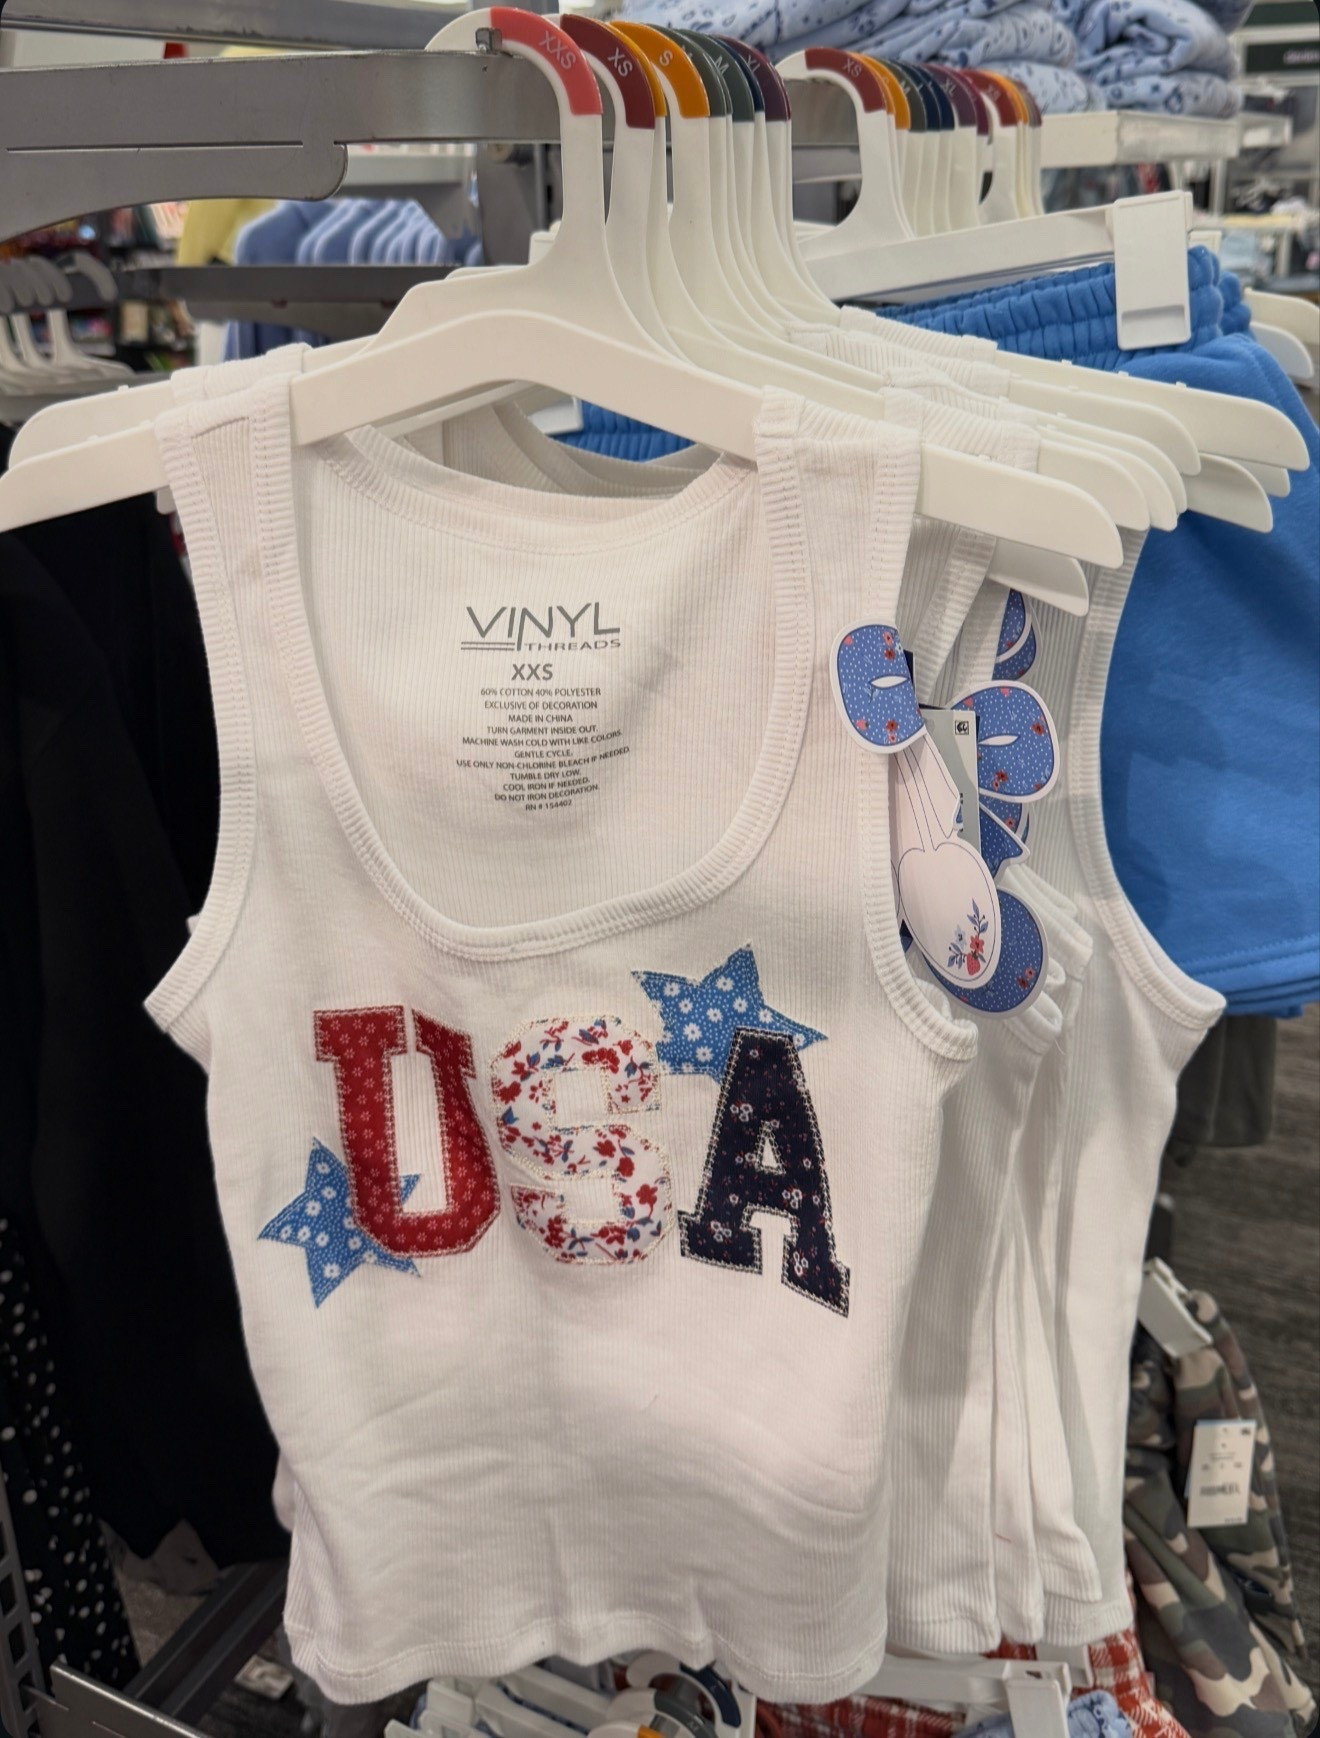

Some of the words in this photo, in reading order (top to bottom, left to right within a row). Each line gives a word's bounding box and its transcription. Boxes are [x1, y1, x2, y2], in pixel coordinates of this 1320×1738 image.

[539, 30, 577, 70] XXS
[607, 47, 634, 77] XS
[658, 50, 674, 67] S
[842, 57, 863, 78] XS
[465, 601, 621, 651] VINYL
[525, 639, 621, 651] THREADS
[511, 663, 554, 681] XXS
[480, 688, 498, 696] 60%
[499, 688, 533, 697] COTTON
[535, 688, 553, 697] 40%
[554, 687, 601, 697] POLYESTER
[484, 700, 527, 710] EXCLUSIVE
[528, 701, 539, 710] OF
[542, 701, 598, 710] DECORATION
[508, 714, 533, 723] MADE
[535, 714, 544, 723] IN
[545, 714, 573, 723] CHINA
[487, 726, 508, 735] TURN
[510, 726, 548, 735] GARMENT
[550, 726, 577, 735] INSIDE
[462, 736, 498, 746] MACHINE
[500, 738, 524, 747] WASH
[525, 738, 548, 747] COLD
[549, 738, 571, 746] WITH
[572, 736, 589, 745] LIKE
[514, 750, 544, 759] GENTLE
[456, 759, 471, 768] USE
[472, 760, 494, 769] ONLY
[496, 761, 556, 770] NON-CHLORINE
[558, 757, 590, 768] BLEACH
[591, 755, 598, 763] IF
[510, 772, 542, 781] TUMBLE
[543, 771, 560, 780] DRY
[503, 783, 526, 792] COOL
[527, 782, 547, 791] IRON
[494, 793, 507, 801] DO
[508, 793, 525, 802] NOT
[527, 793, 547, 801] IRON
[525, 803, 537, 812] RN
[313, 1004, 850, 1319] USA
